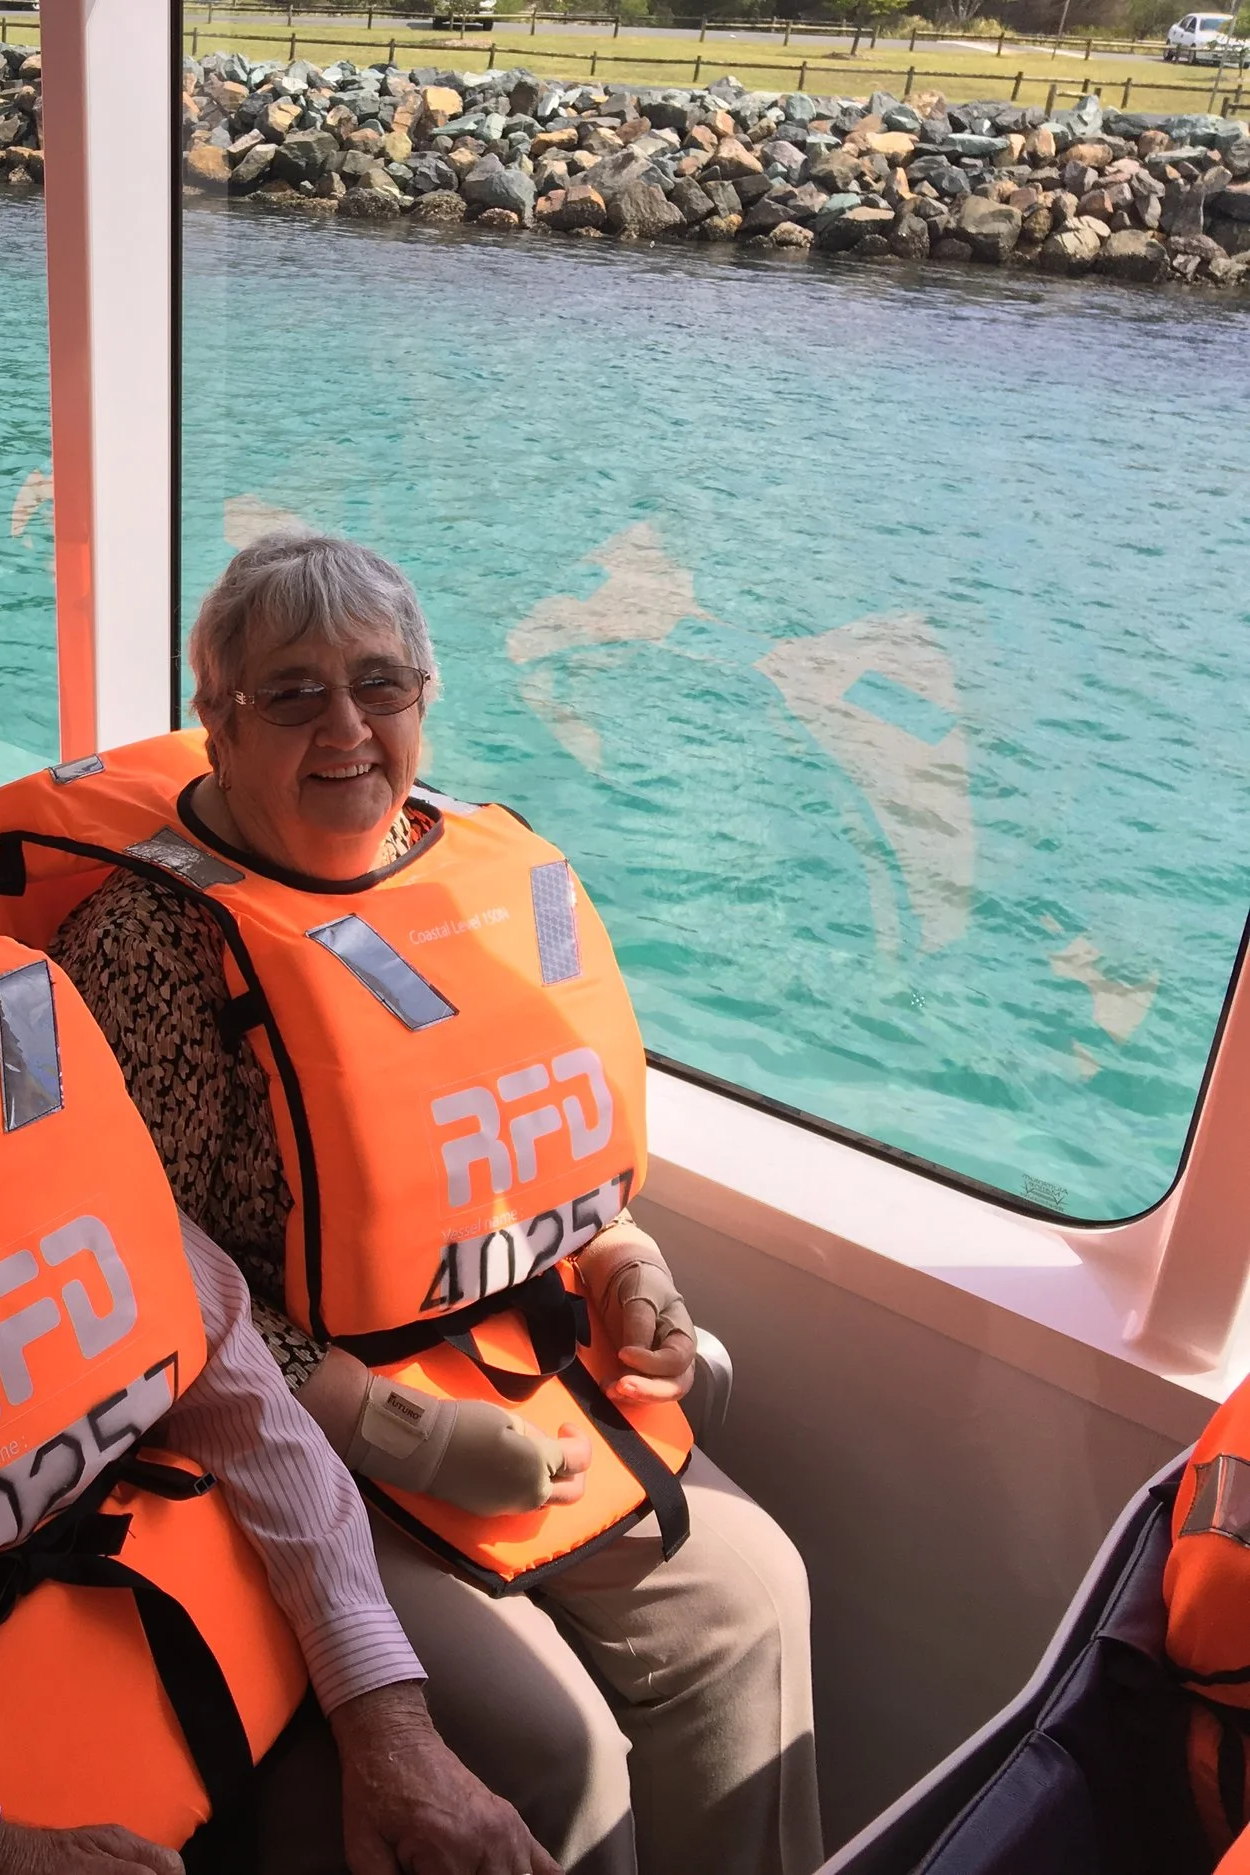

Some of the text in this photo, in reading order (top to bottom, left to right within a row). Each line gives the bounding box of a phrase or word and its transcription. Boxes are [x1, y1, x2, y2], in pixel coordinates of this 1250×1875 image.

[408, 920, 451, 945] Coastal
[450, 913, 482, 935] Level
[431, 1047, 615, 1209] RFD
